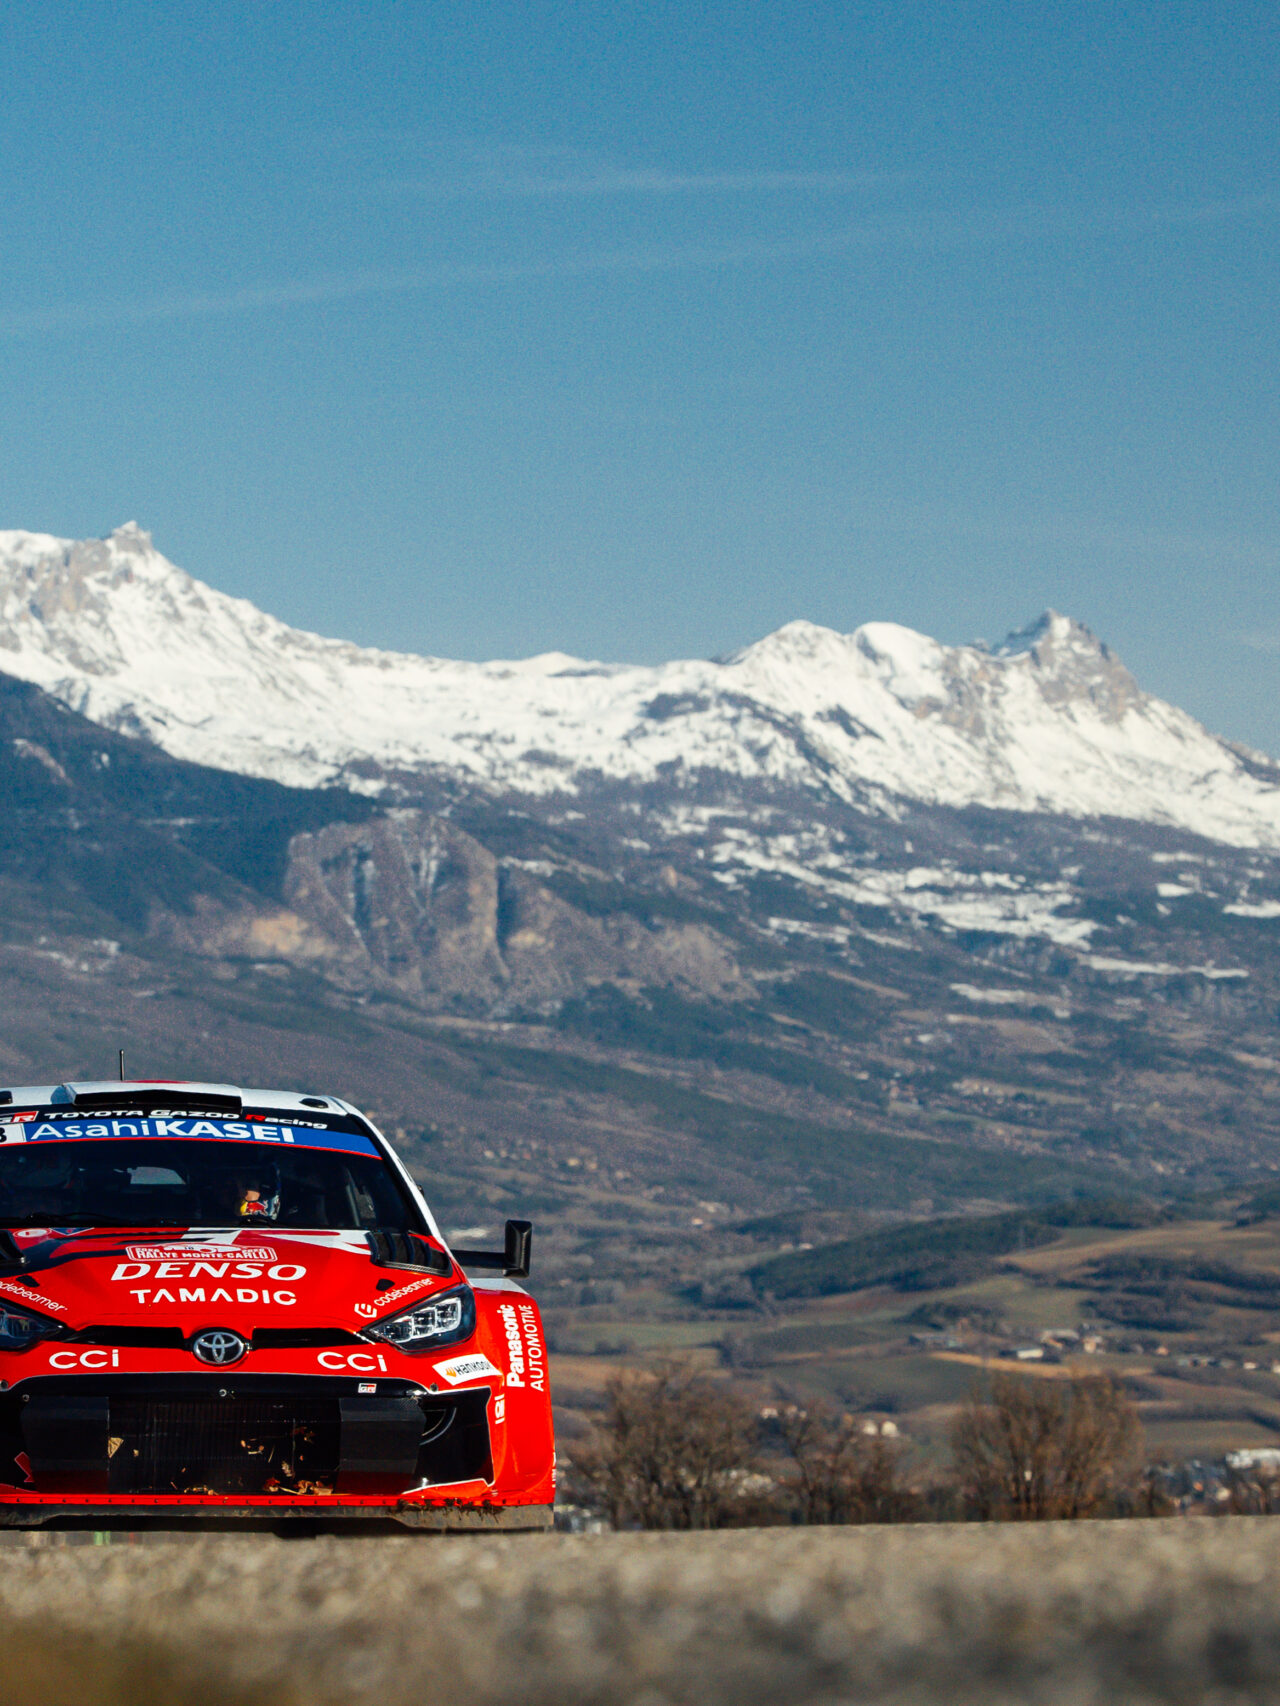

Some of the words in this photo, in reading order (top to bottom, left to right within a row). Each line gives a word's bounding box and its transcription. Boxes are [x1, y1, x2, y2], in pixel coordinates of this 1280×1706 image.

[44, 1110, 144, 1120] TOYOTA
[245, 1114, 328, 1130] Racing
[135, 1250, 179, 1259] RALLYE
[110, 1262, 307, 1281] DENSO
[129, 1287, 297, 1306] TAMADIC
[373, 1277, 435, 1306] codebeamer
[497, 1304, 525, 1388] Panasonic
[518, 1304, 544, 1392] AUTOMOTIVE
